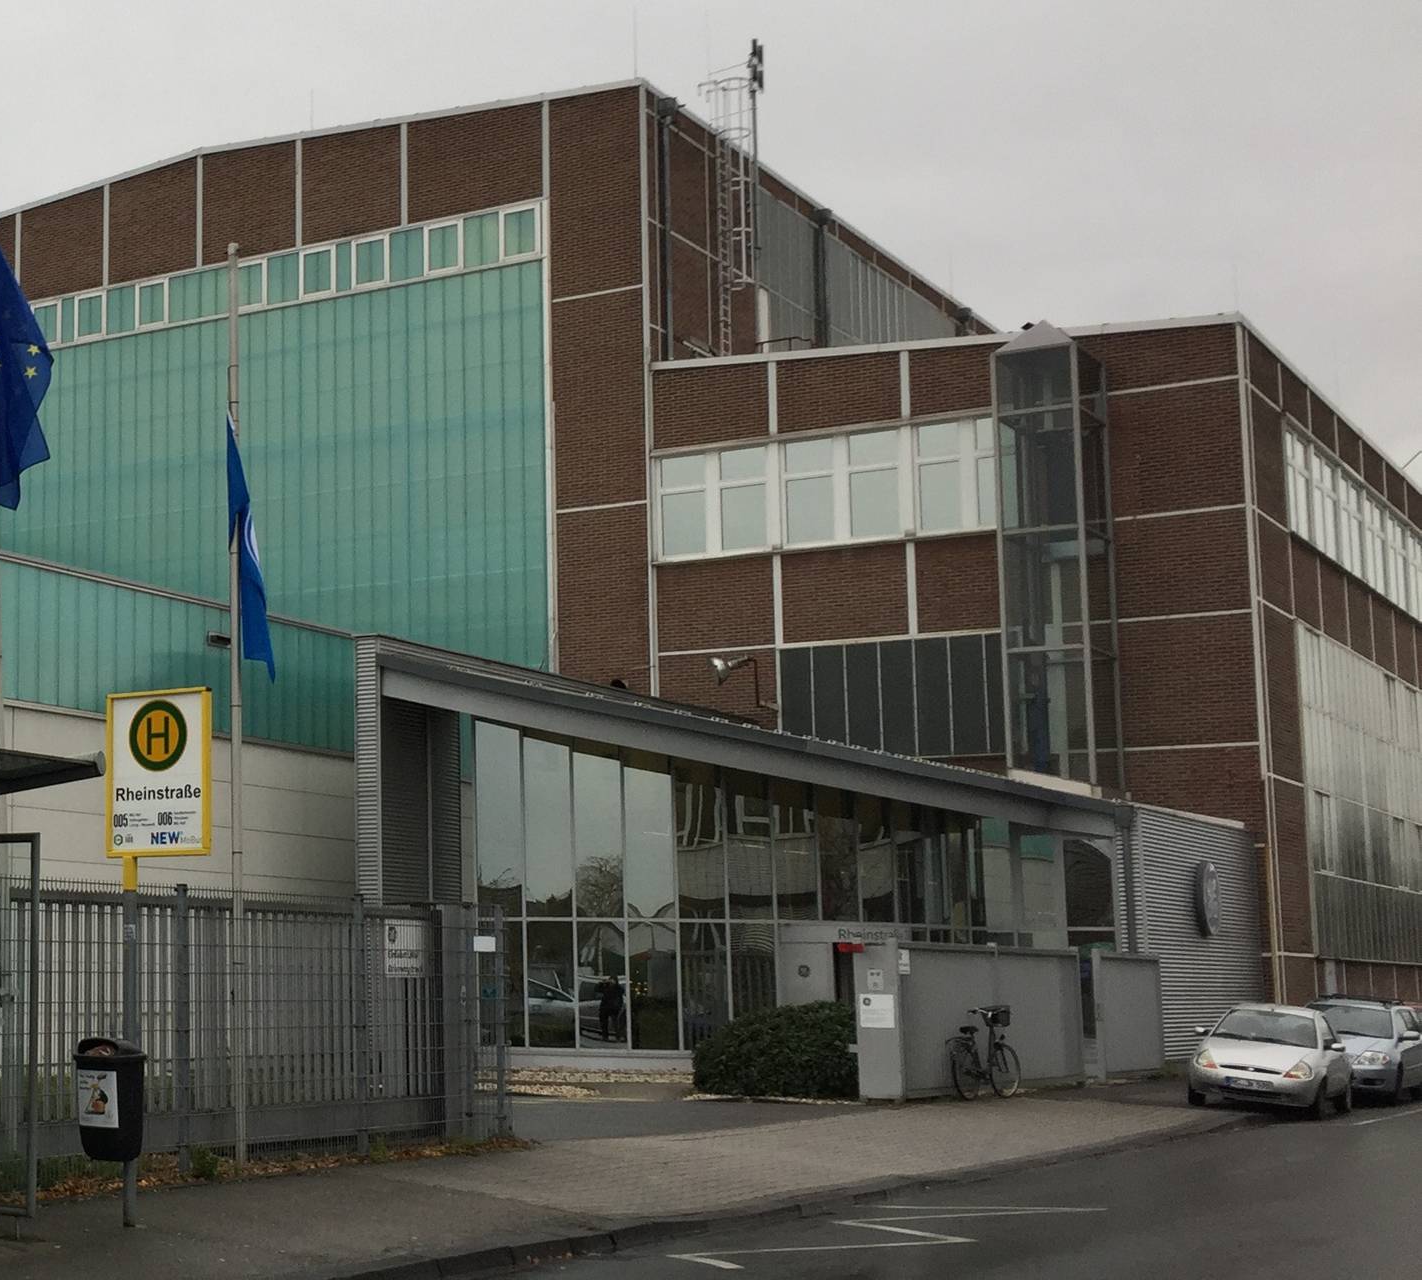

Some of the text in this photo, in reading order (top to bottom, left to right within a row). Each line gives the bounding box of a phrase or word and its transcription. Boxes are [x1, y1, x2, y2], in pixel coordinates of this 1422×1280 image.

[146, 715, 170, 755] H
[116, 784, 202, 802] Rheinstraße
[114, 813, 128, 828] 005
[157, 811, 173, 826] 006
[150, 831, 180, 845] NEW
